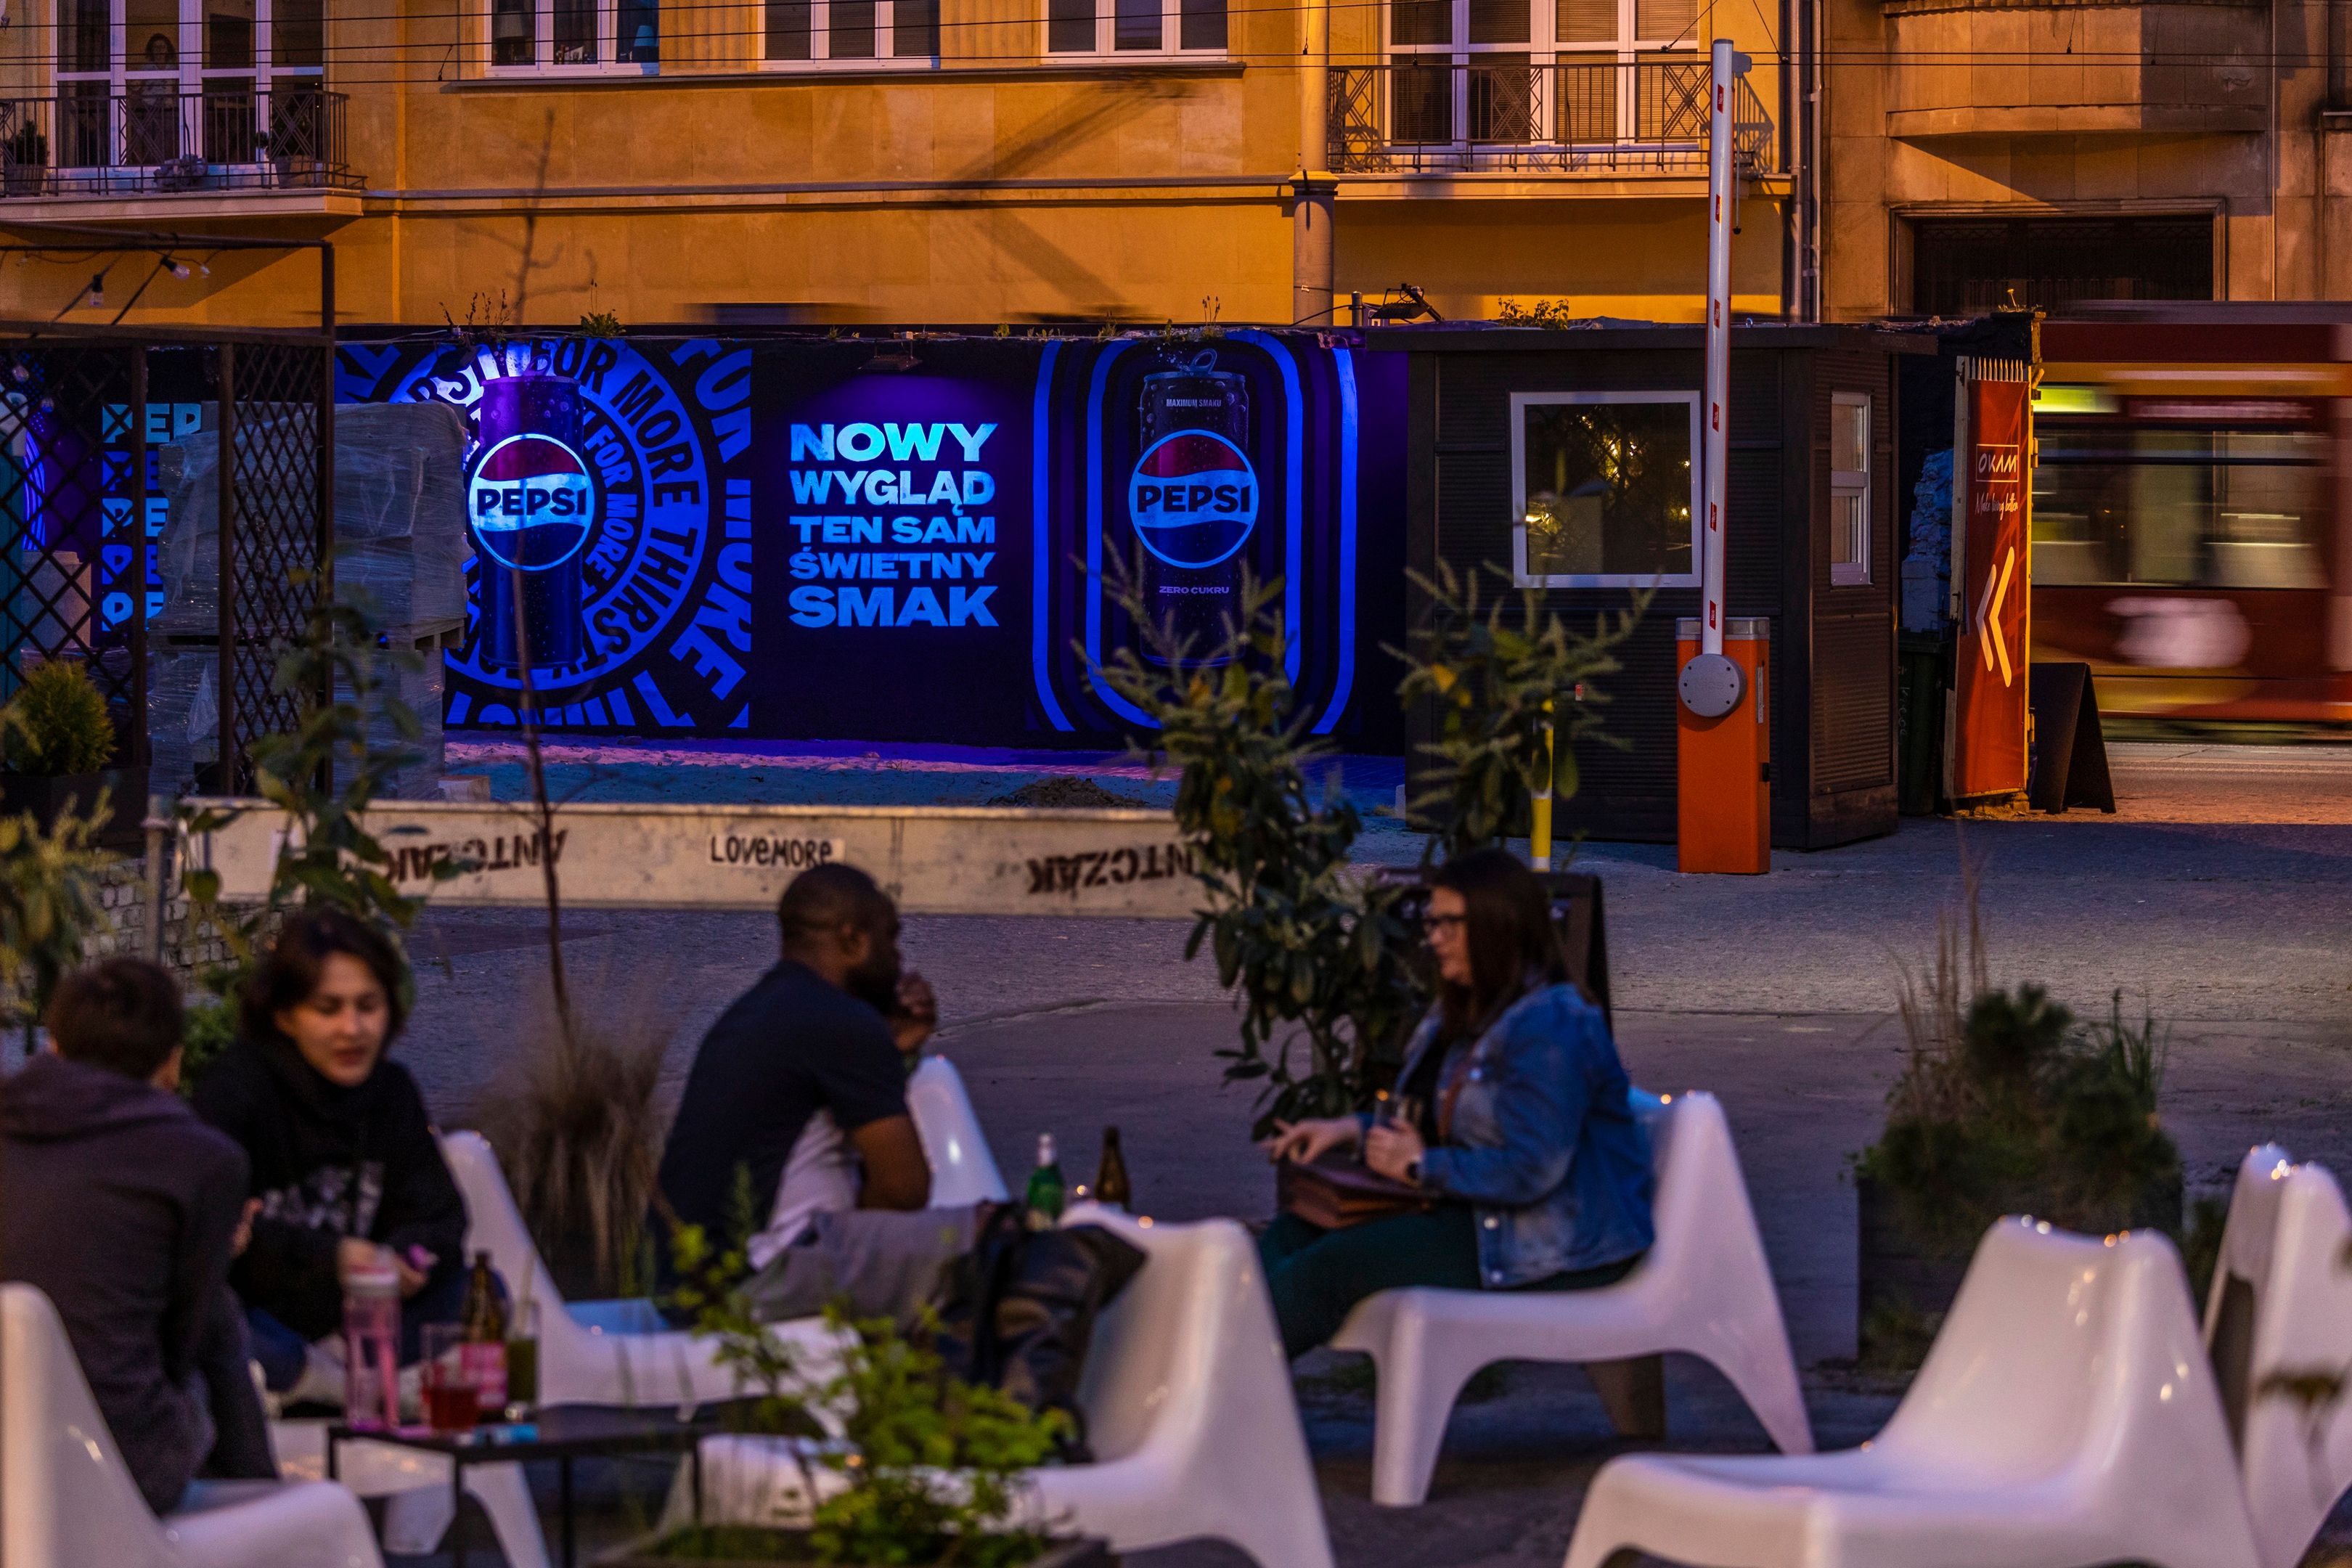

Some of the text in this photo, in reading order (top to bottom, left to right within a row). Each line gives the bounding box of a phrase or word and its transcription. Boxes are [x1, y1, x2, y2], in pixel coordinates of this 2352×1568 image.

[1166, 399, 1198, 407] MAXIMUM
[584, 424, 634, 489] FOR
[609, 369, 700, 507] MORE
[791, 422, 998, 462] NOWY
[477, 487, 587, 516] PEPSI
[789, 470, 995, 516] WYGLĄD
[1138, 485, 1251, 513] PEPSI
[584, 493, 637, 581] MORE
[789, 516, 995, 543] TEN SAM
[789, 547, 997, 579] ŚWIETNY
[553, 527, 698, 679] THIRST
[788, 585, 999, 628] SMAK
[1026, 844, 1194, 894] NTCZAK
